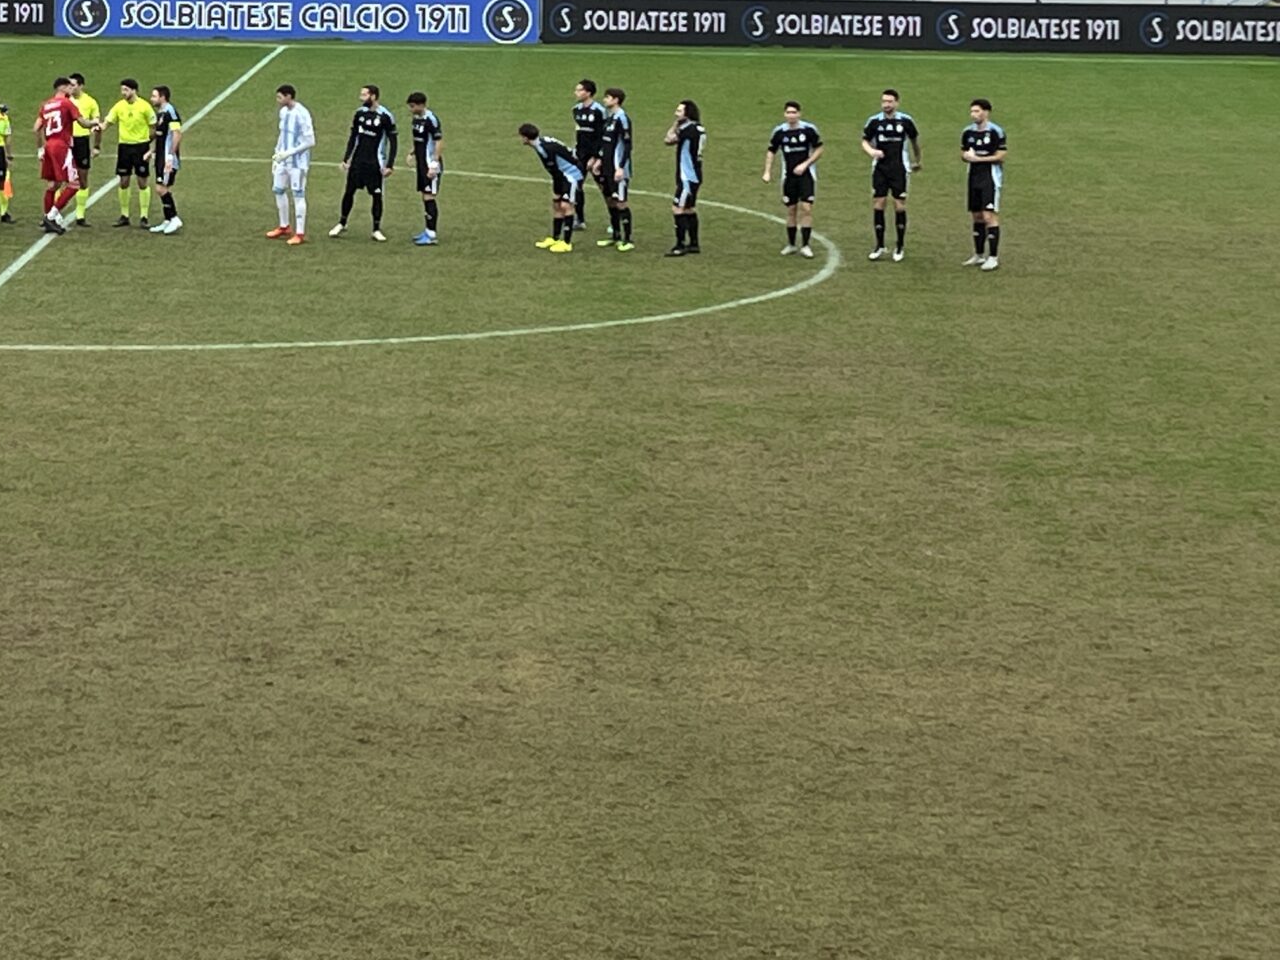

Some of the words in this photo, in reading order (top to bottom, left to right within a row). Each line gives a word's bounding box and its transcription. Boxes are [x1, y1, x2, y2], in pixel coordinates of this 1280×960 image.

[14, 3, 43, 22] 1911
[120, 0, 293, 32] SOLBIATESE
[299, 2, 410, 33] CALCIO
[416, 4, 470, 34] 1911
[584, 11, 687, 31] SOLBIATESE
[693, 12, 725, 32] 1911
[776, 15, 882, 35] SOLBIATESE
[888, 16, 921, 36] 1911
[971, 18, 1080, 39] SOLBIATESE
[1086, 20, 1119, 39] 1911
